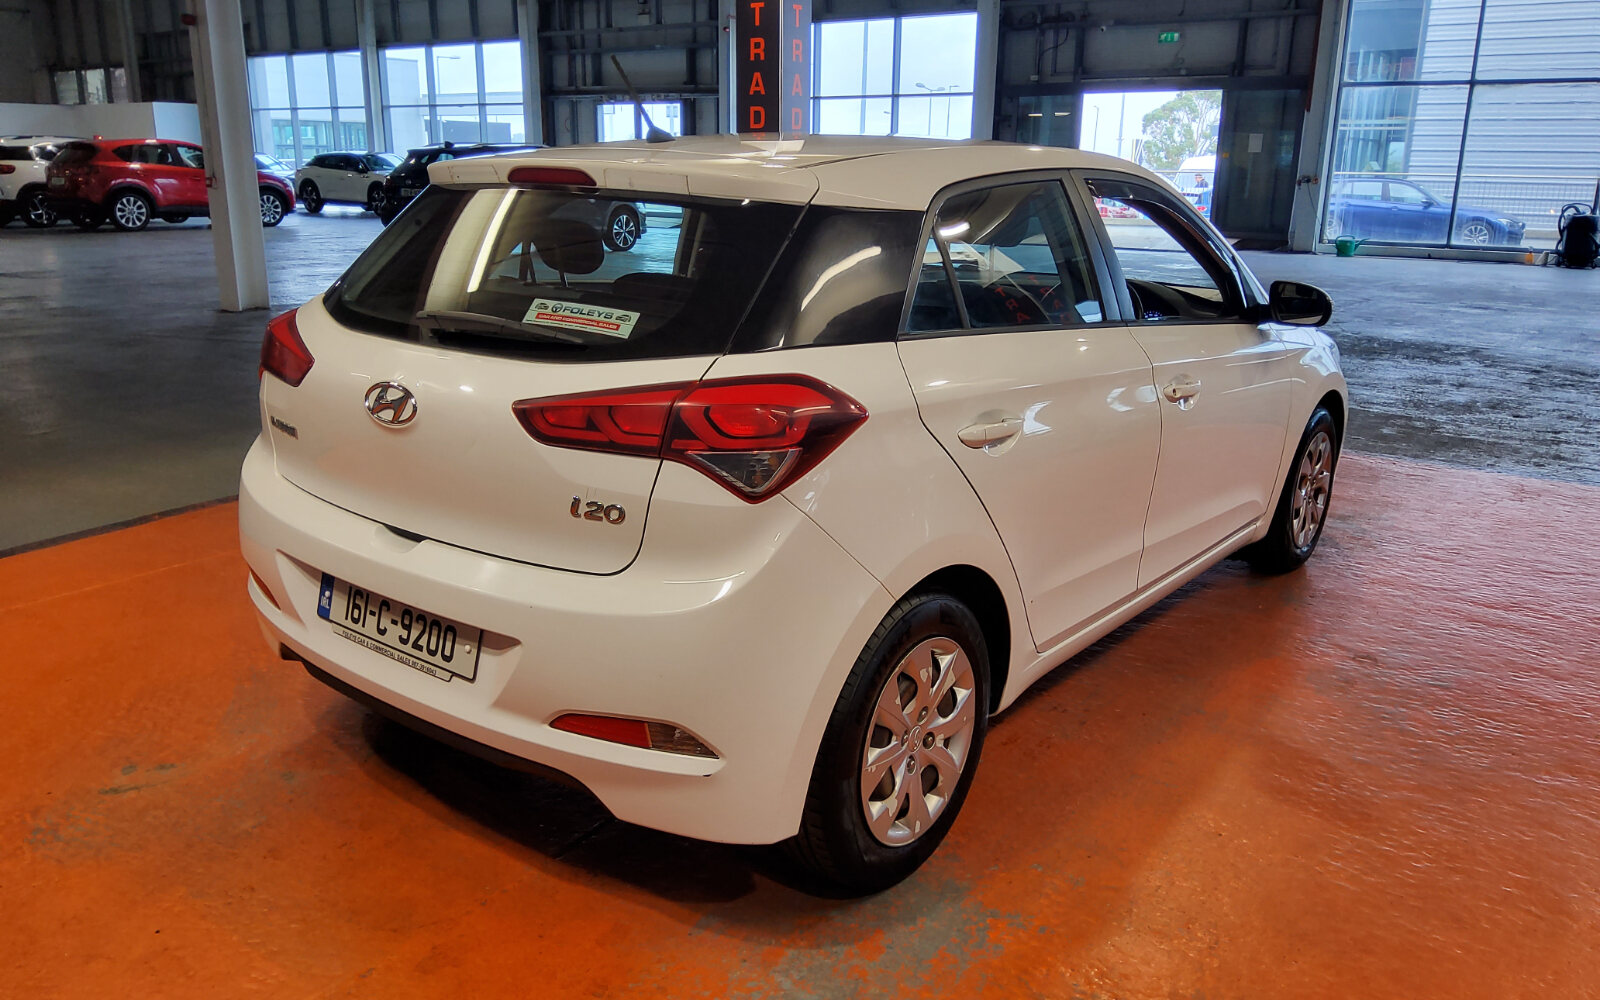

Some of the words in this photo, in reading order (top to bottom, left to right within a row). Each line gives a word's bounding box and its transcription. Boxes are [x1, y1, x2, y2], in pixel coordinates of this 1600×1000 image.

[749, 2, 766, 129] TRAD
[791, 3, 803, 130] TRAD
[562, 306, 614, 320] FOLEYS
[598, 322, 617, 330] SALES
[570, 495, 626, 525] i20
[344, 586, 457, 663] 161-C-9200
[357, 636, 366, 645] CAR
[397, 654, 411, 665] SALES
